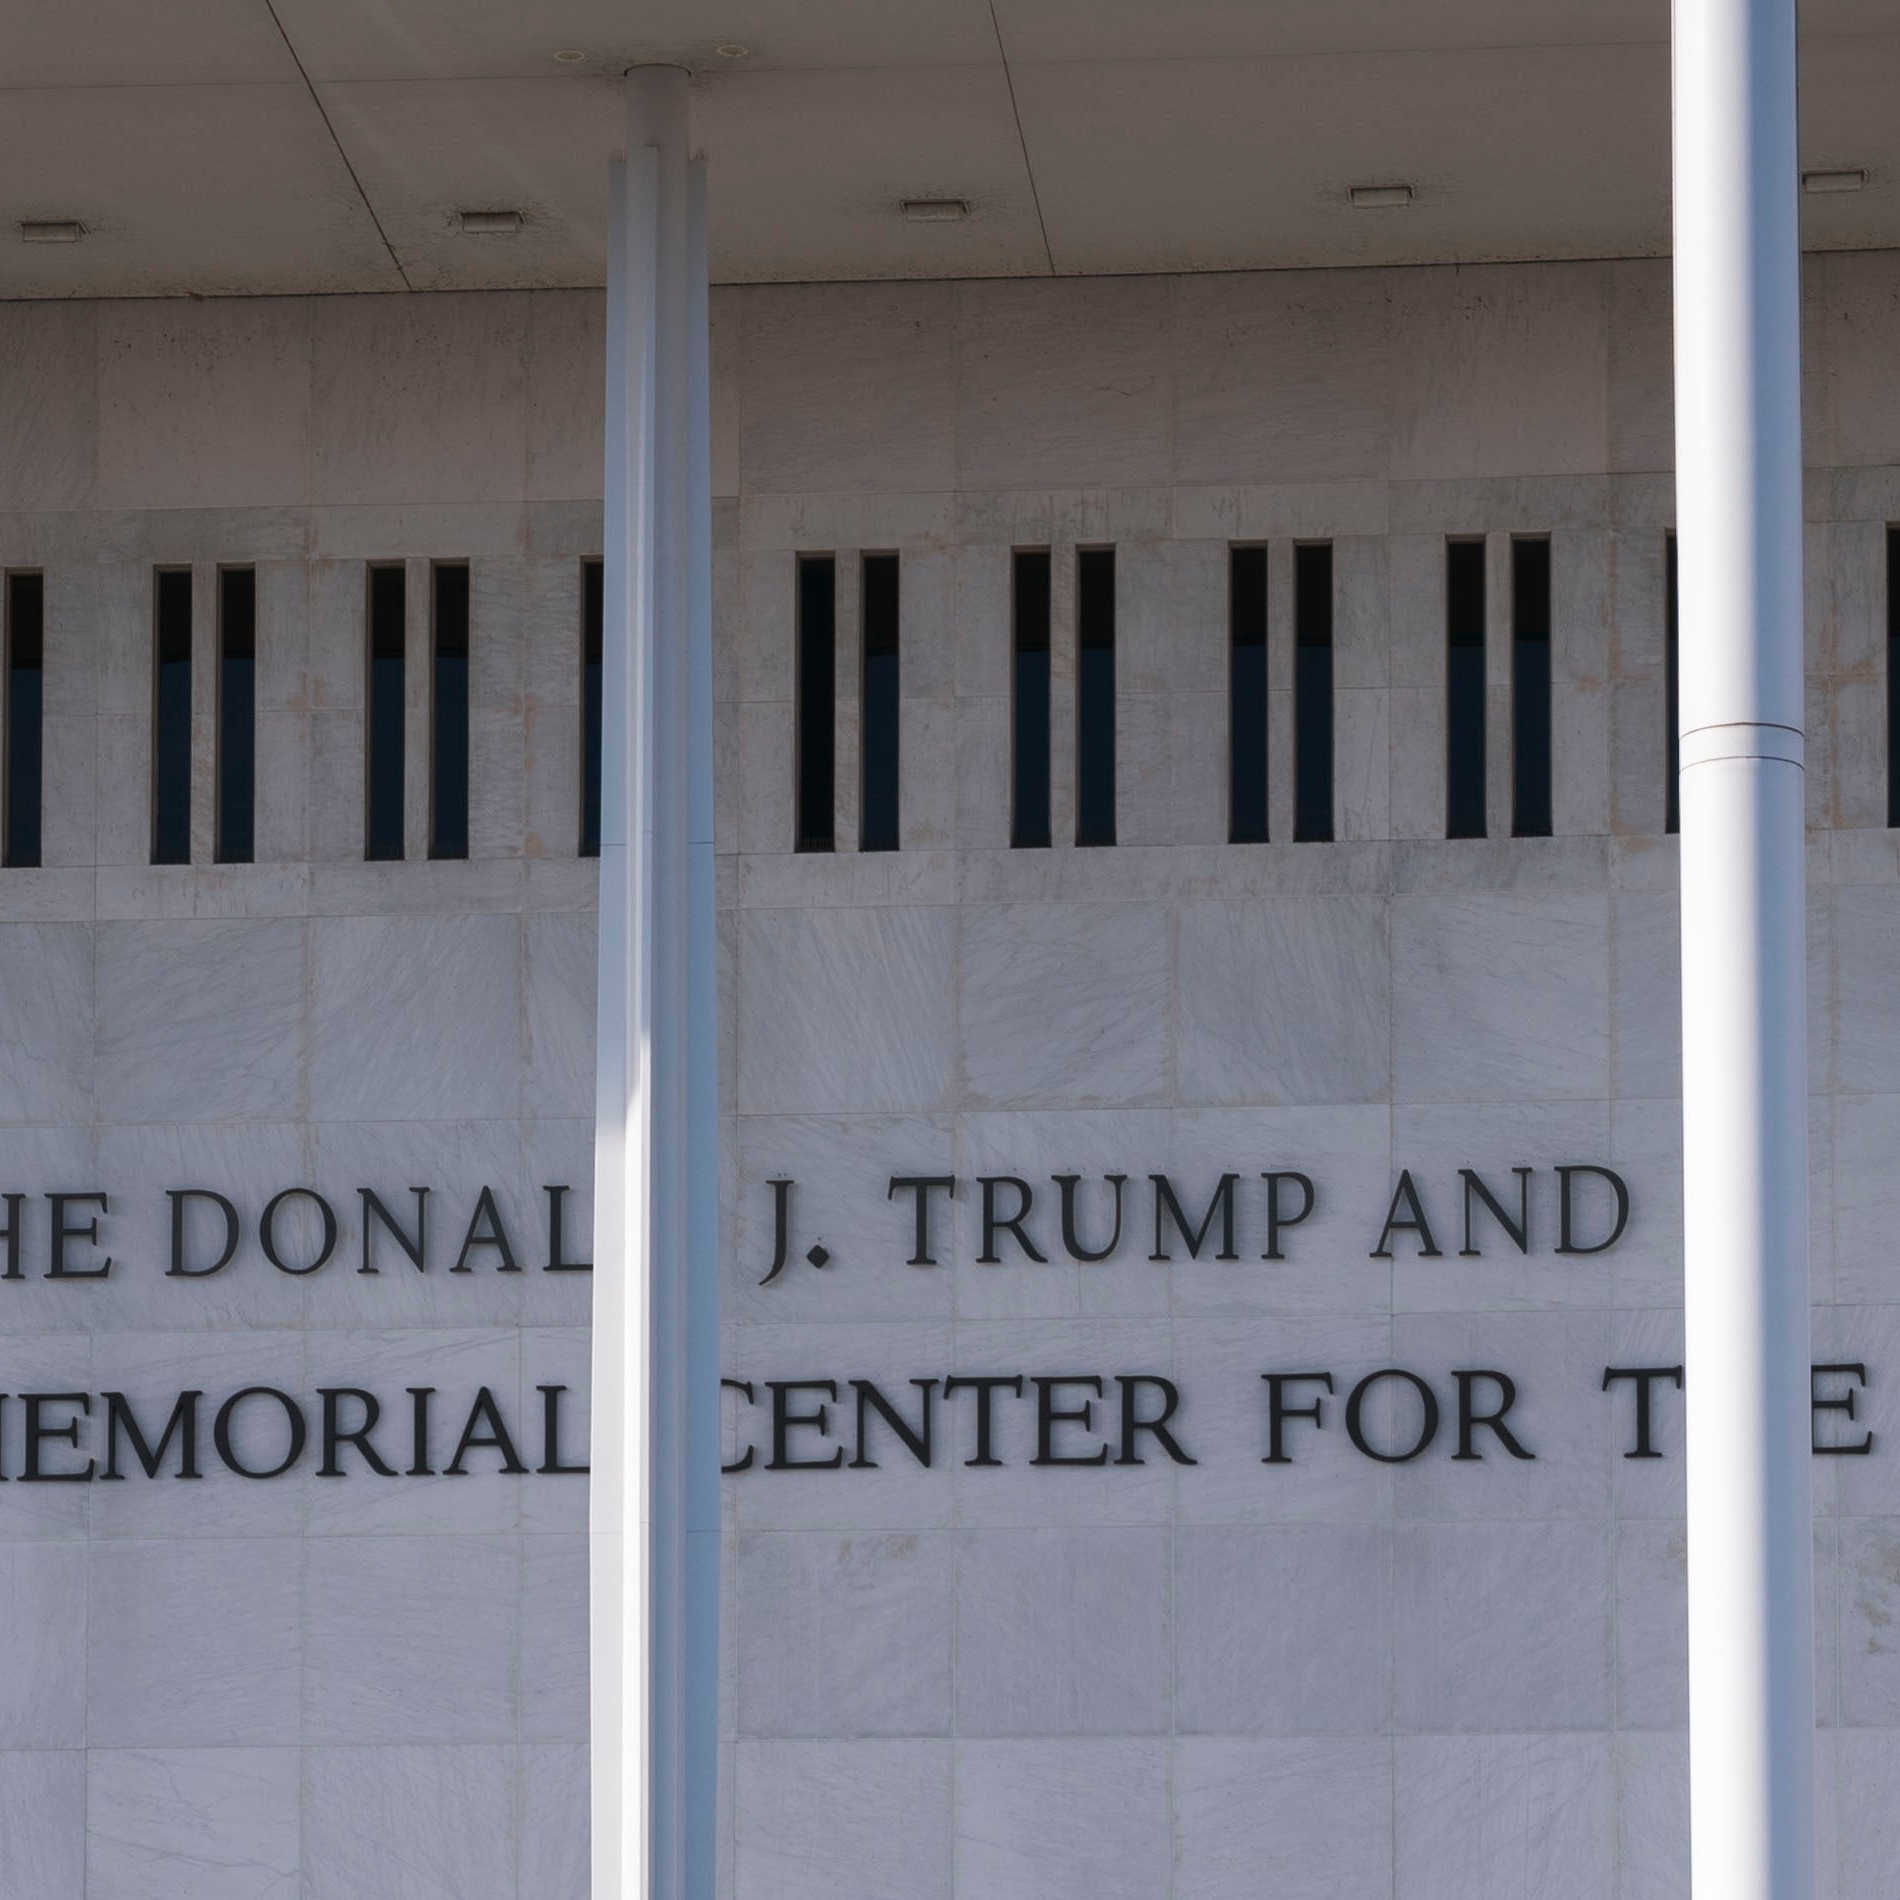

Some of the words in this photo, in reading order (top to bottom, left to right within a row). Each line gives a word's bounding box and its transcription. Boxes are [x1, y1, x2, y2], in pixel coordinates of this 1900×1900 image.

[166, 1186, 593, 1277] DONAL
[758, 1180, 830, 1286] J.
[888, 1172, 1314, 1265] TRUMP
[1370, 1166, 1628, 1257] AND
[1261, 1369, 1535, 1463] FOR
[1602, 1363, 1872, 1458] TE
